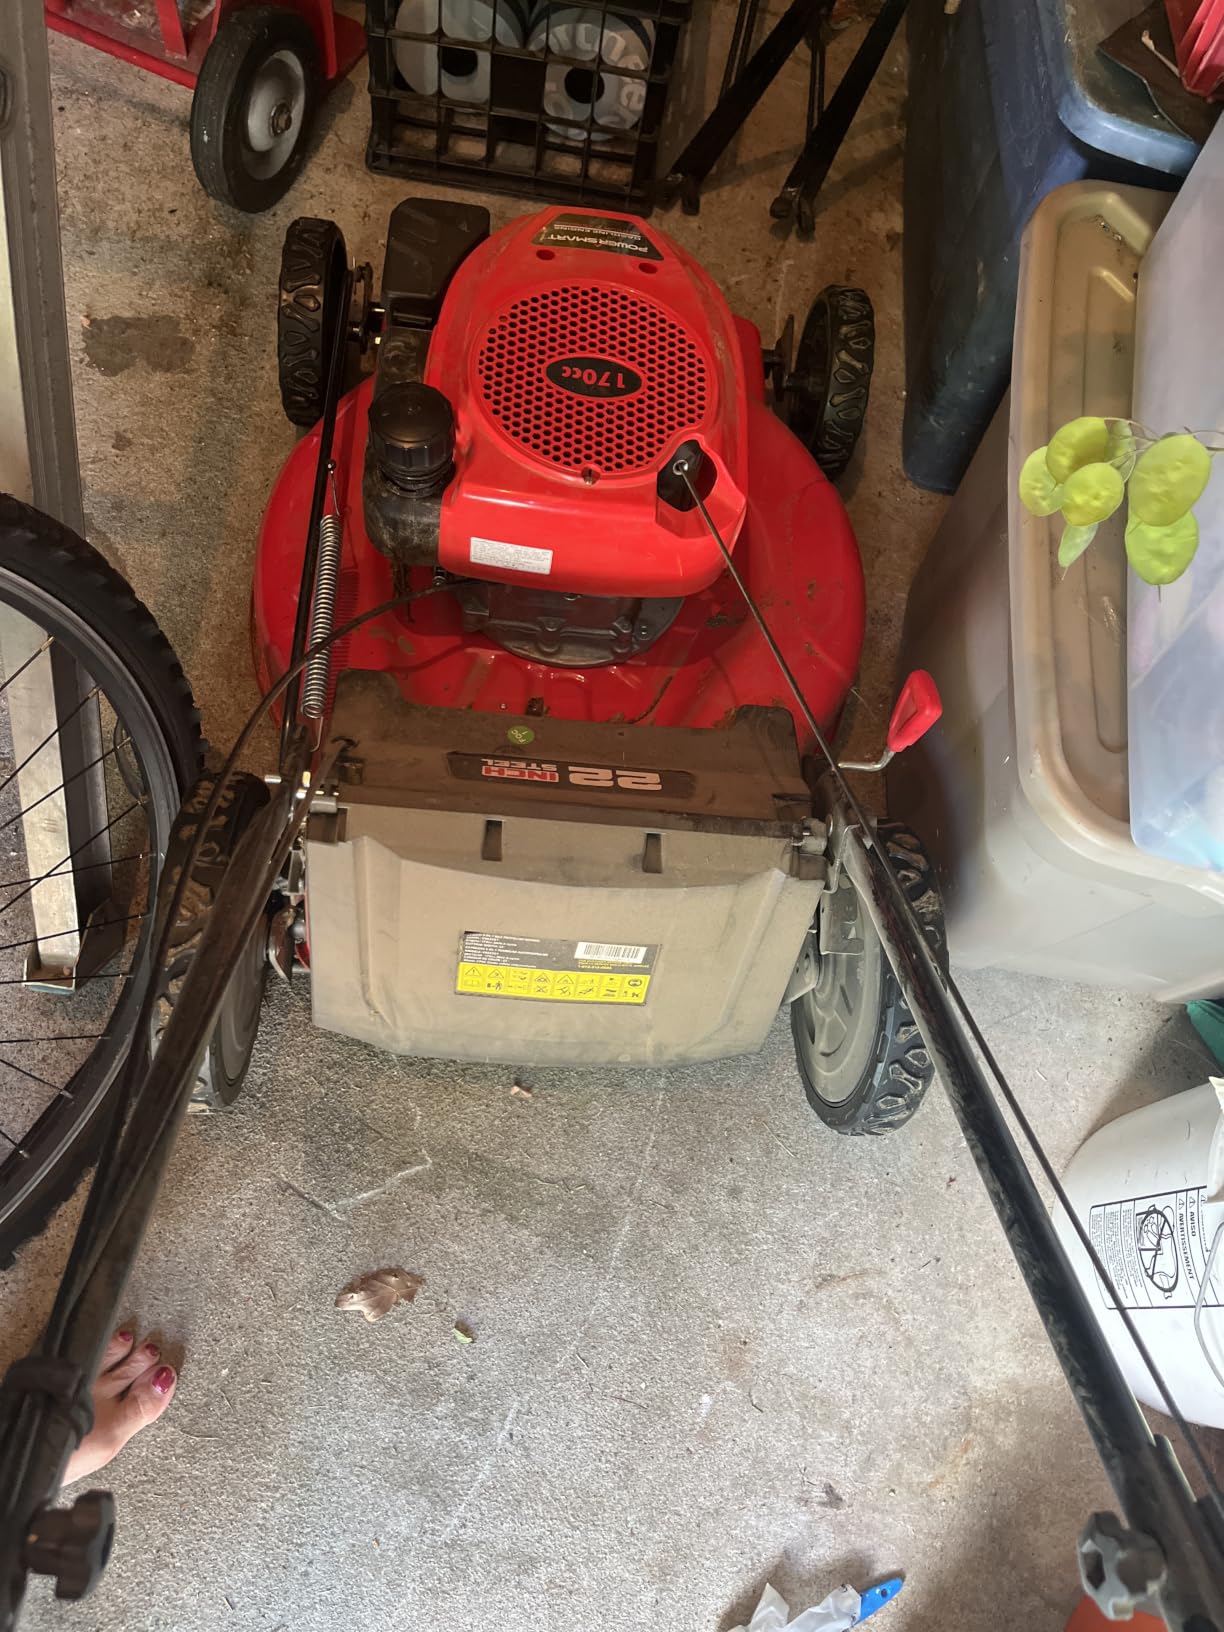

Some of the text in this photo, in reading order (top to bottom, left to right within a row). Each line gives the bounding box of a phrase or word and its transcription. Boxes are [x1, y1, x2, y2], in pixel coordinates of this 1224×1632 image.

[561, 366, 625, 388] 170cc
[481, 759, 558, 771] STEEL
[482, 766, 558, 782] INCH
[567, 766, 662, 791] 22
[1189, 1211, 1197, 1237] AVISO
[1178, 1213, 1194, 1279] AVERTISSEMENT
